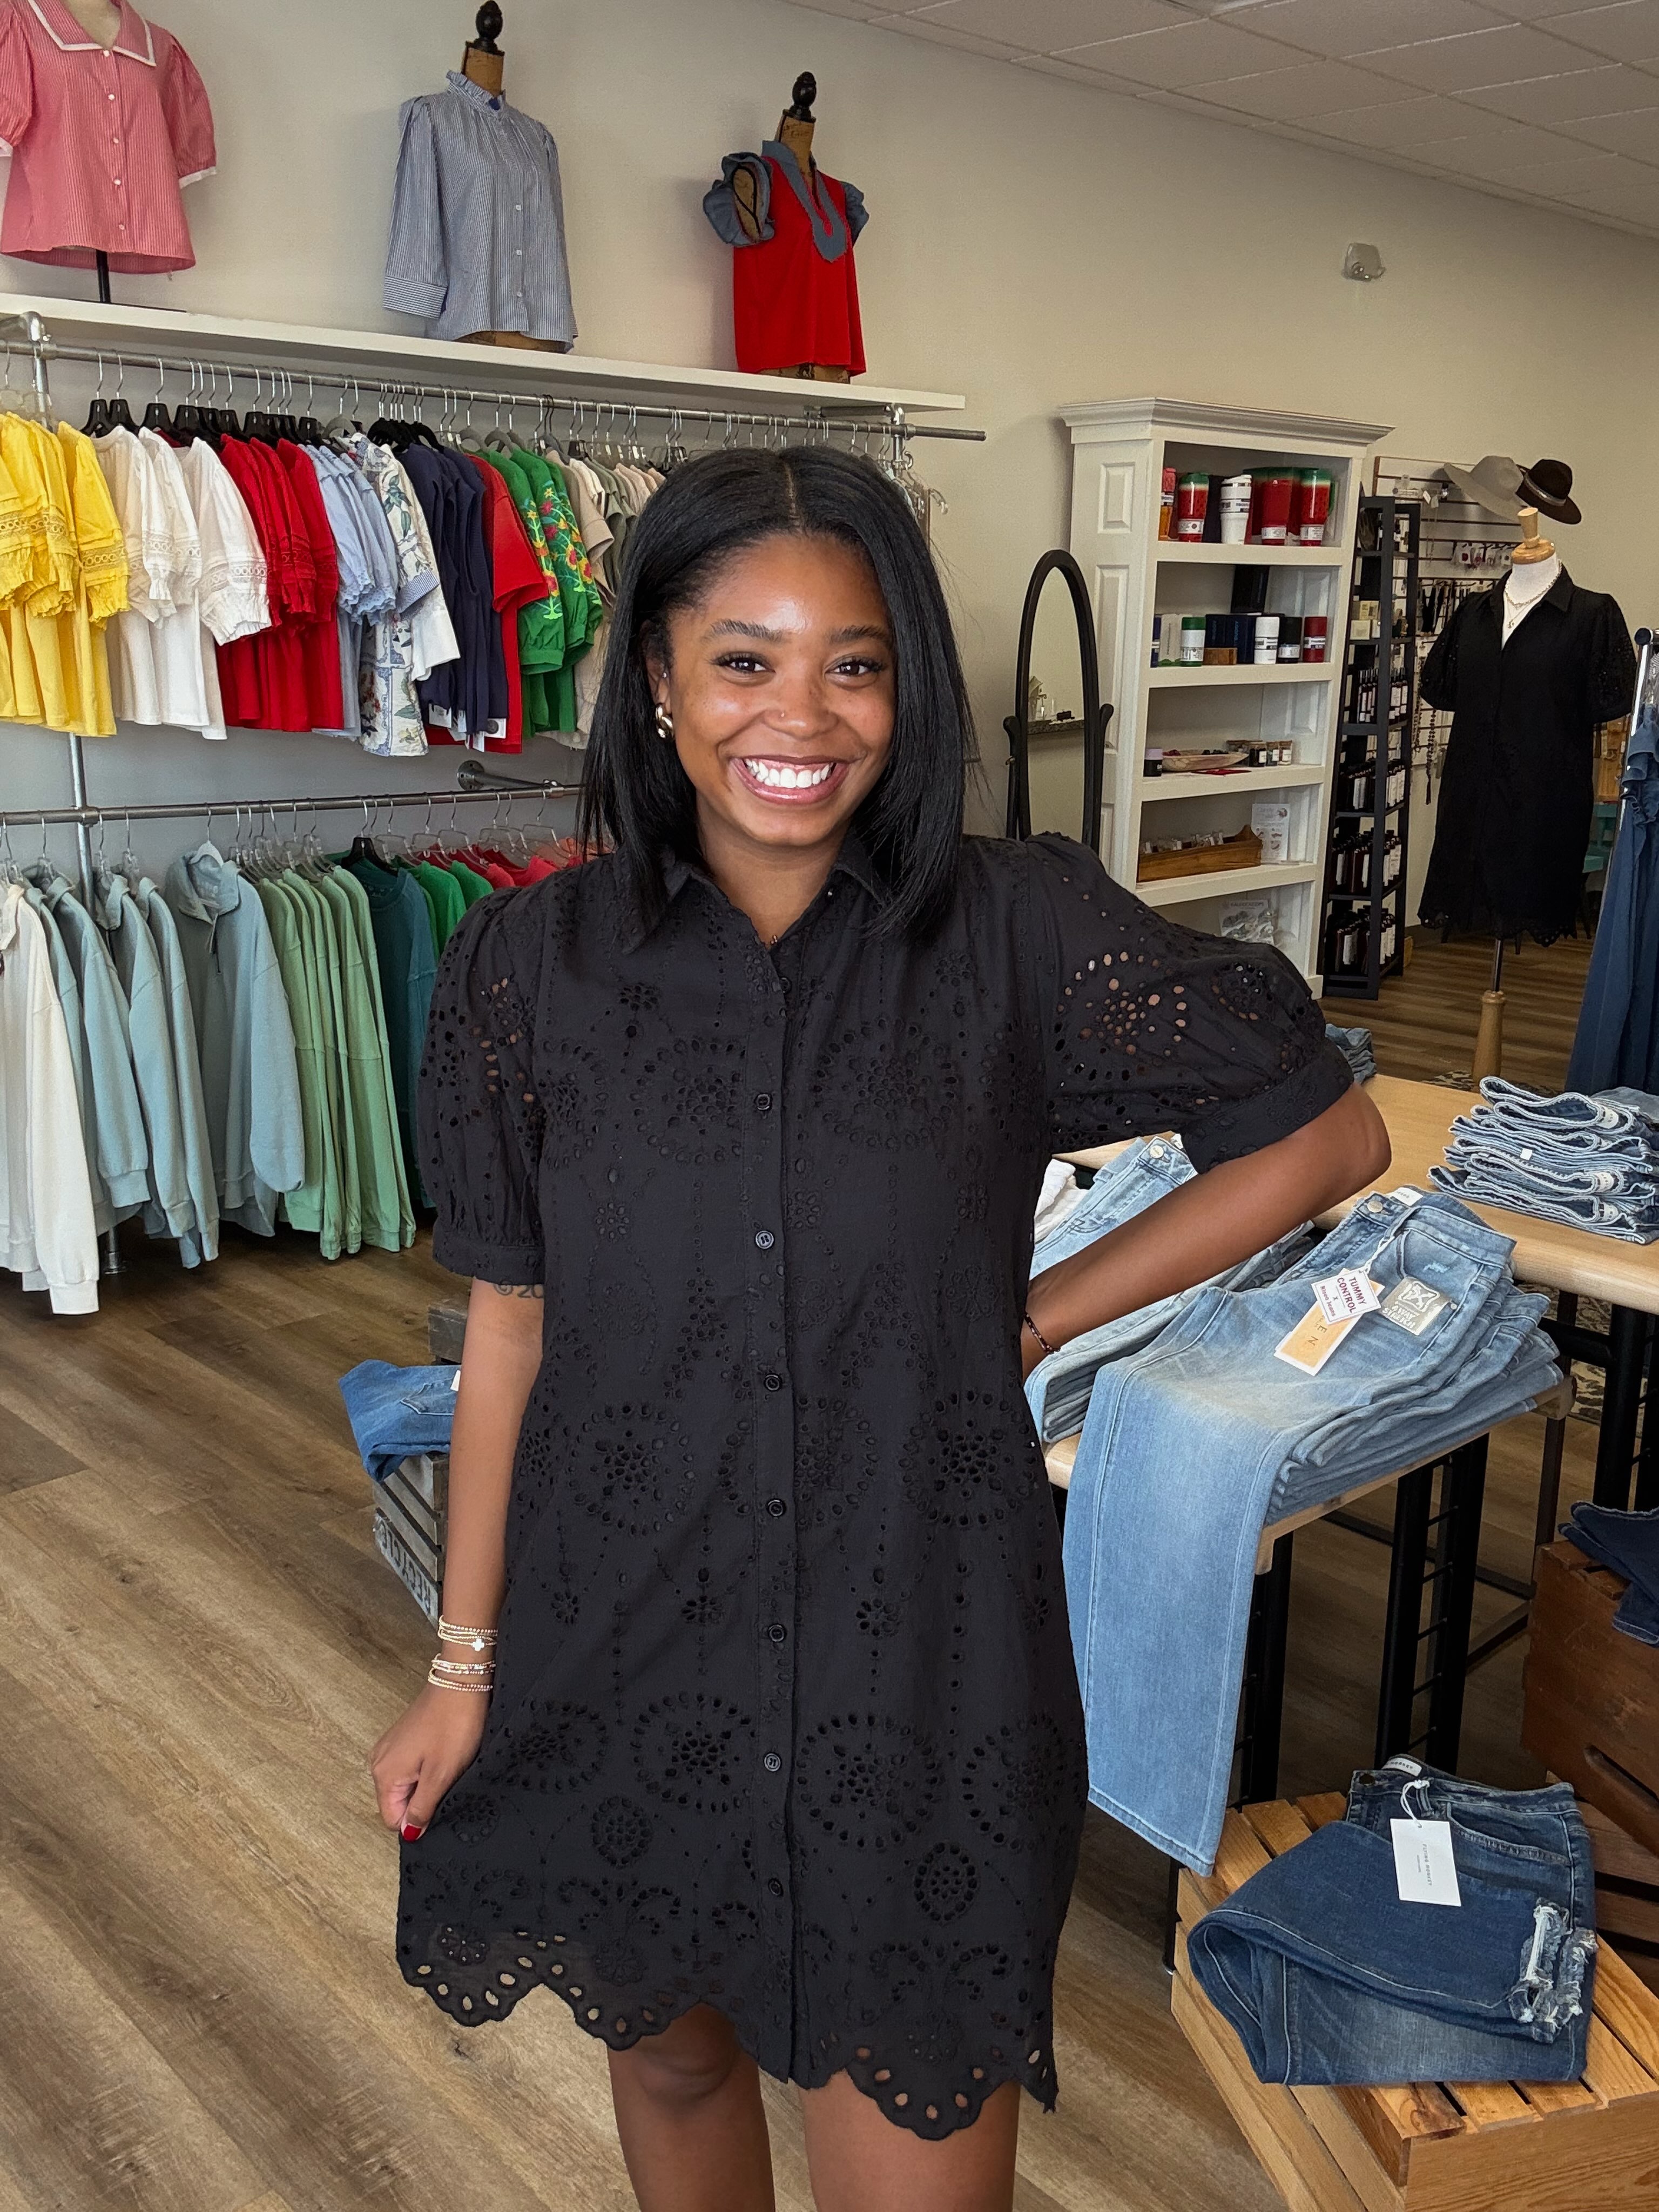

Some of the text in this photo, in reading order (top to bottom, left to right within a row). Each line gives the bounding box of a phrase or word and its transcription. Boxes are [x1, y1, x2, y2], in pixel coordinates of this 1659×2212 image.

[1337, 1277, 1357, 1313] CONTROL
[1348, 1276, 1367, 1305] TUMMY
[1382, 1308, 1416, 1328] STRETCH
